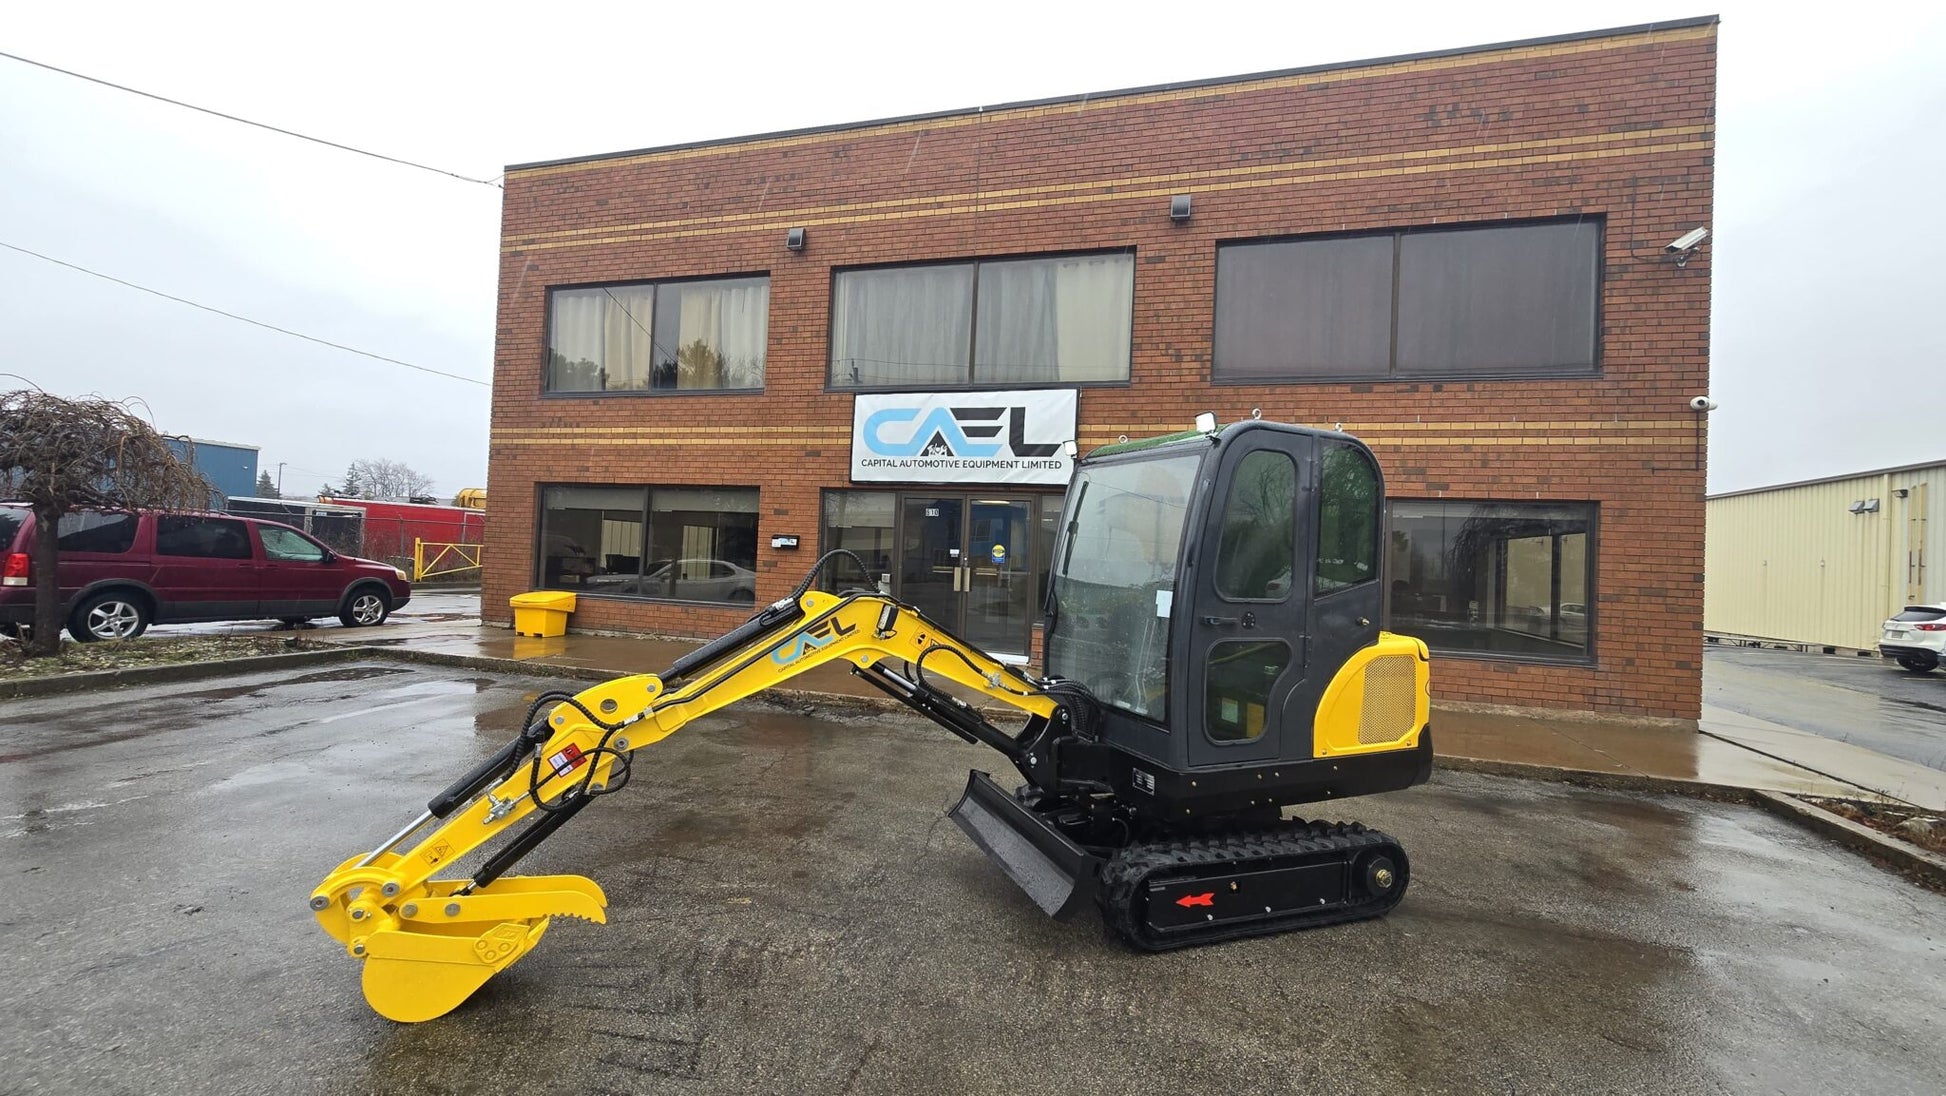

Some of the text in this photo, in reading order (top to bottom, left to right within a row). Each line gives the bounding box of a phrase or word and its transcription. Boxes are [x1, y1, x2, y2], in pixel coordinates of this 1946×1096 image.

[863, 407, 1062, 457] CAEL
[861, 458, 1062, 470] CAPITAL AUTOMOTIVE EQUIPMENT LIMITED
